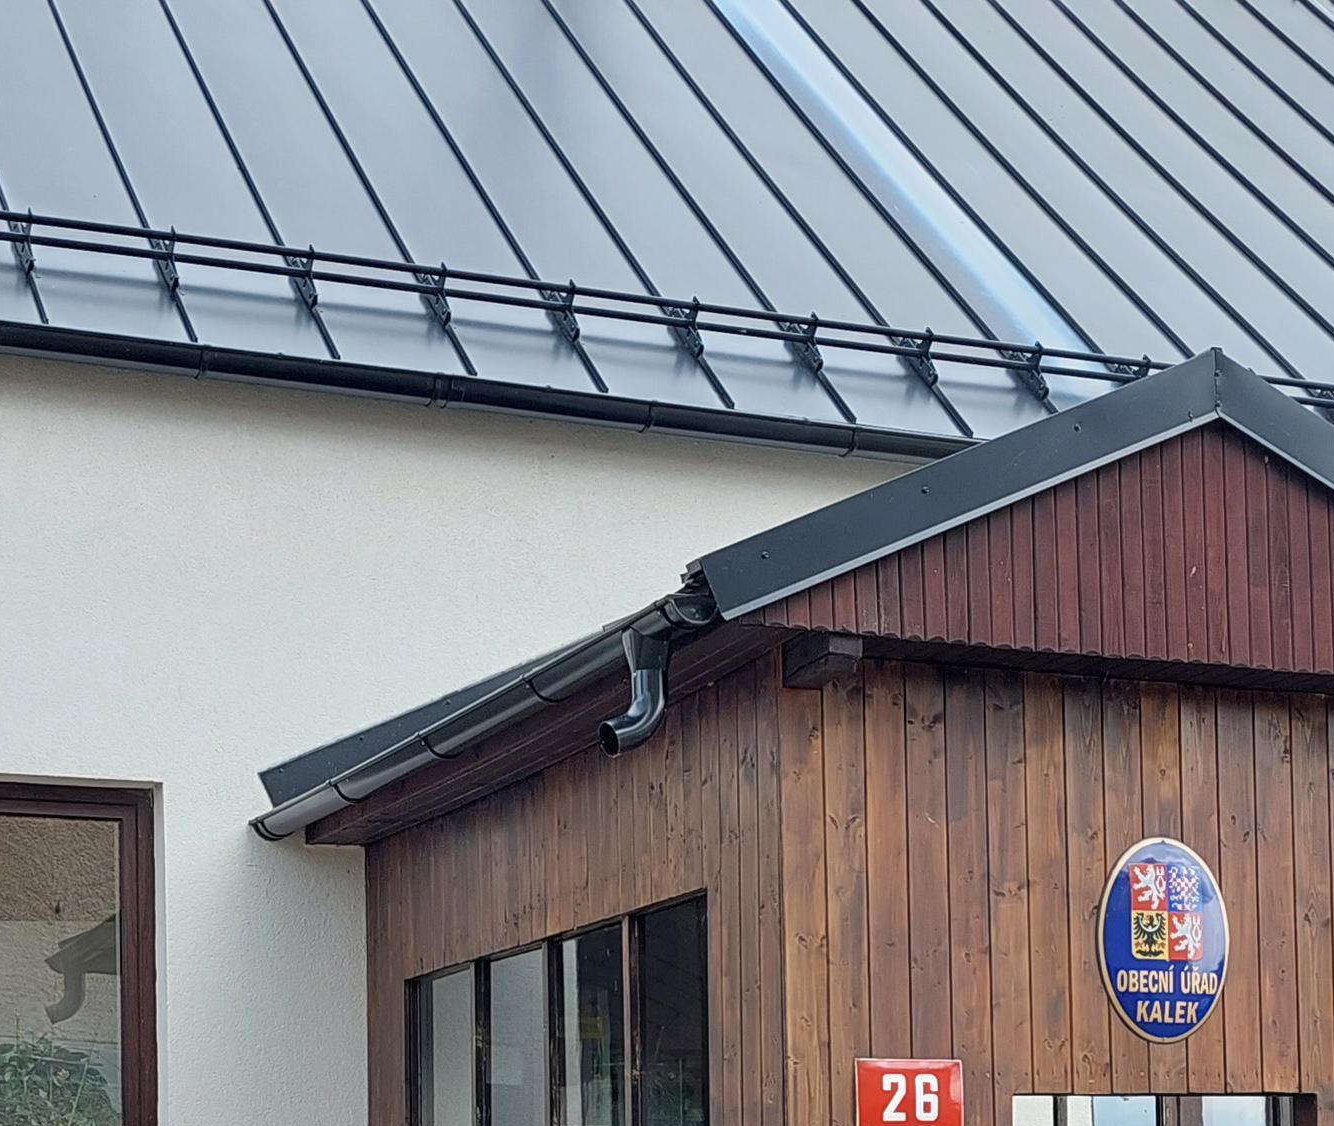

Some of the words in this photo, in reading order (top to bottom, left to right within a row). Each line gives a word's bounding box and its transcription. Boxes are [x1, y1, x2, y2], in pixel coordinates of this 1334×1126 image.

[1116, 965, 1174, 993] OBECNÍ
[1181, 965, 1218, 995] ÚŘAD
[1136, 1000, 1199, 1024] KALEK
[882, 1073, 939, 1122] 26
